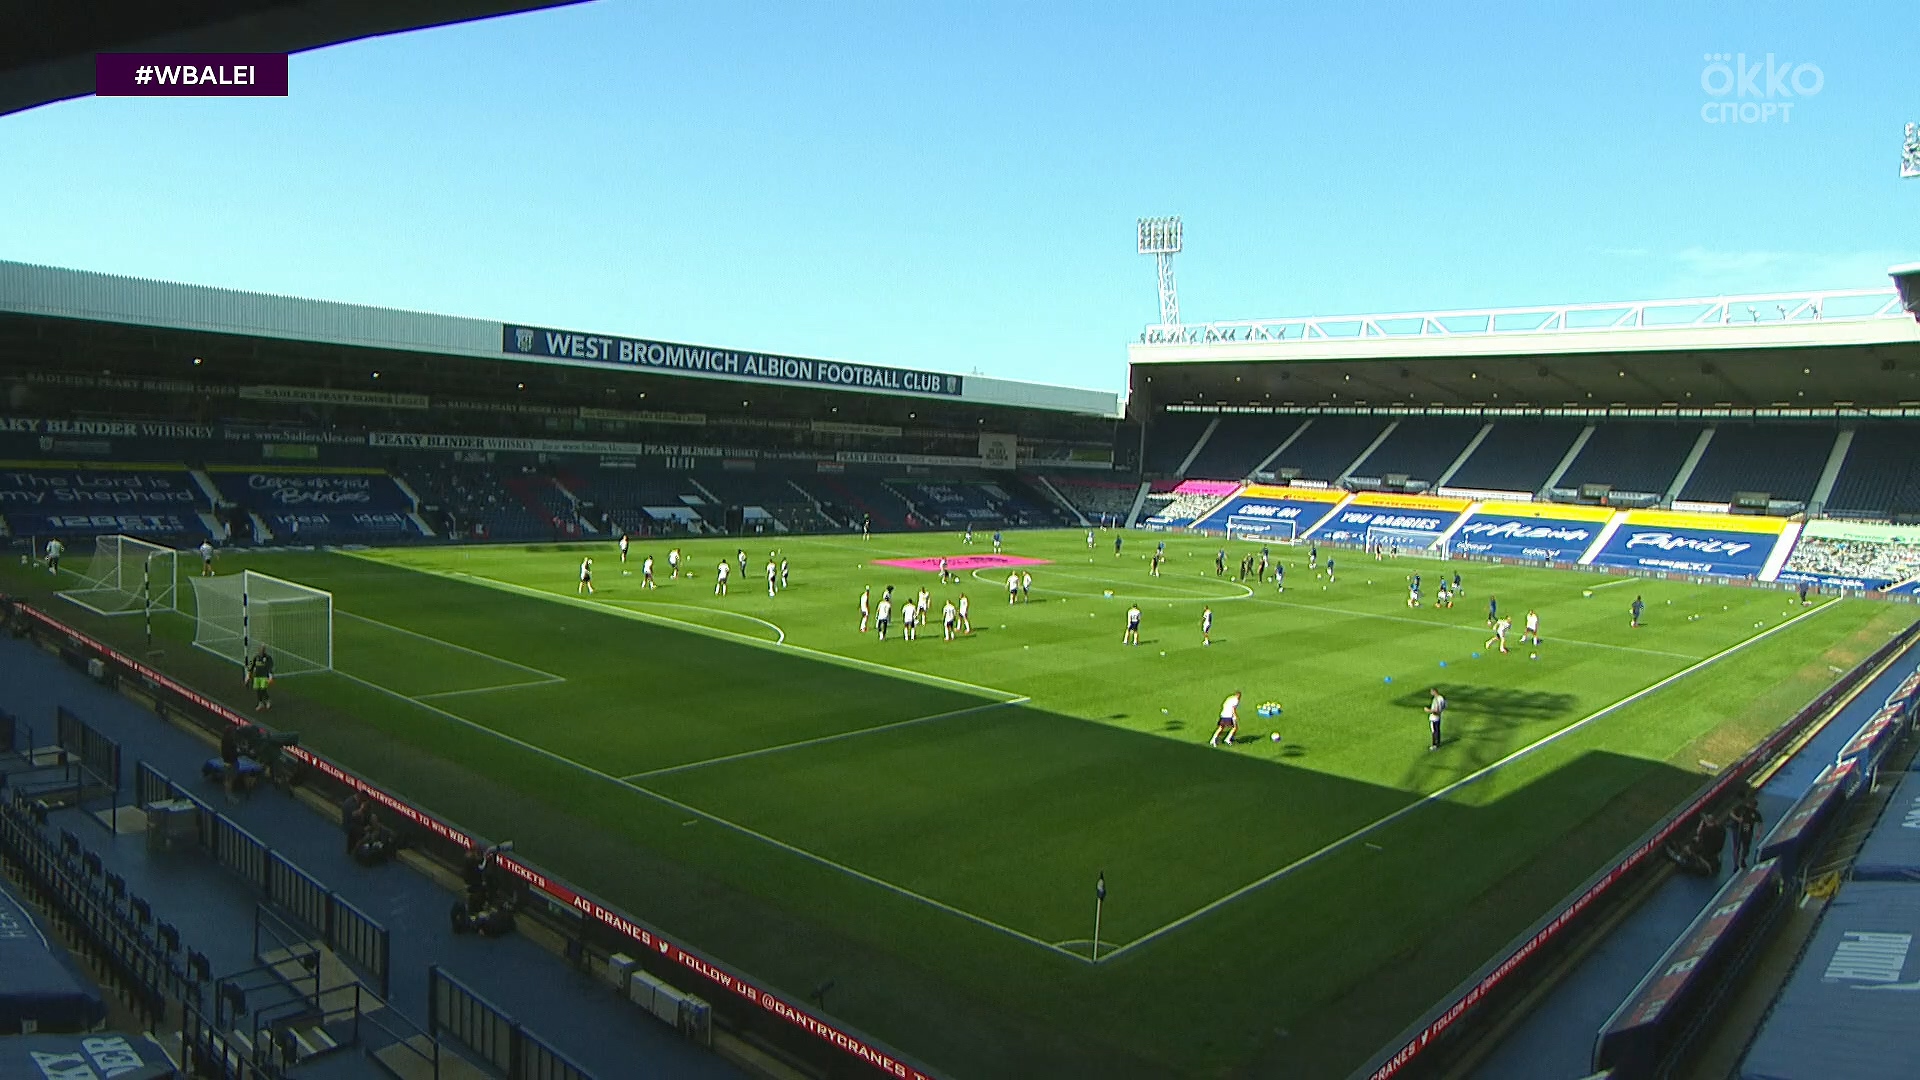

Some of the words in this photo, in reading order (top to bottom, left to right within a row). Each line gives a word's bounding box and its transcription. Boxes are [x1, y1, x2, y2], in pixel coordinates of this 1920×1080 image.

[545, 332, 611, 360] WEST
[618, 340, 736, 373] BROMWICH
[744, 355, 811, 380] ALBION
[817, 363, 899, 388] FOOTBALL
[903, 373, 940, 392] CLUB
[45, 420, 137, 436] BLINDER
[142, 424, 214, 439] WHISKEY
[373, 433, 421, 446] PEAKY
[425, 434, 483, 449] BLINDER
[486, 439, 532, 450] WHISKEY
[6, 473, 68, 486] The
[75, 475, 142, 487] Lord
[148, 477, 170, 487] is
[54, 488, 194, 504] Shepherd
[1238, 504, 1281, 516] COME
[1277, 507, 1301, 518] ON
[1340, 512, 1372, 524] YOU
[1370, 514, 1440, 530] BAGGIES
[418, 815, 430, 827] TO
[430, 820, 446, 836] WIN
[448, 828, 471, 848] WBA
[506, 860, 545, 888] TICKETS
[574, 895, 592, 914] AG
[595, 905, 651, 945] CRANES
[678, 950, 731, 986] FOLLOW
[736, 982, 757, 1001] US
[761, 992, 906, 1079] @GANTRYCRANES
[1432, 998, 1466, 1034] FOLLOW
